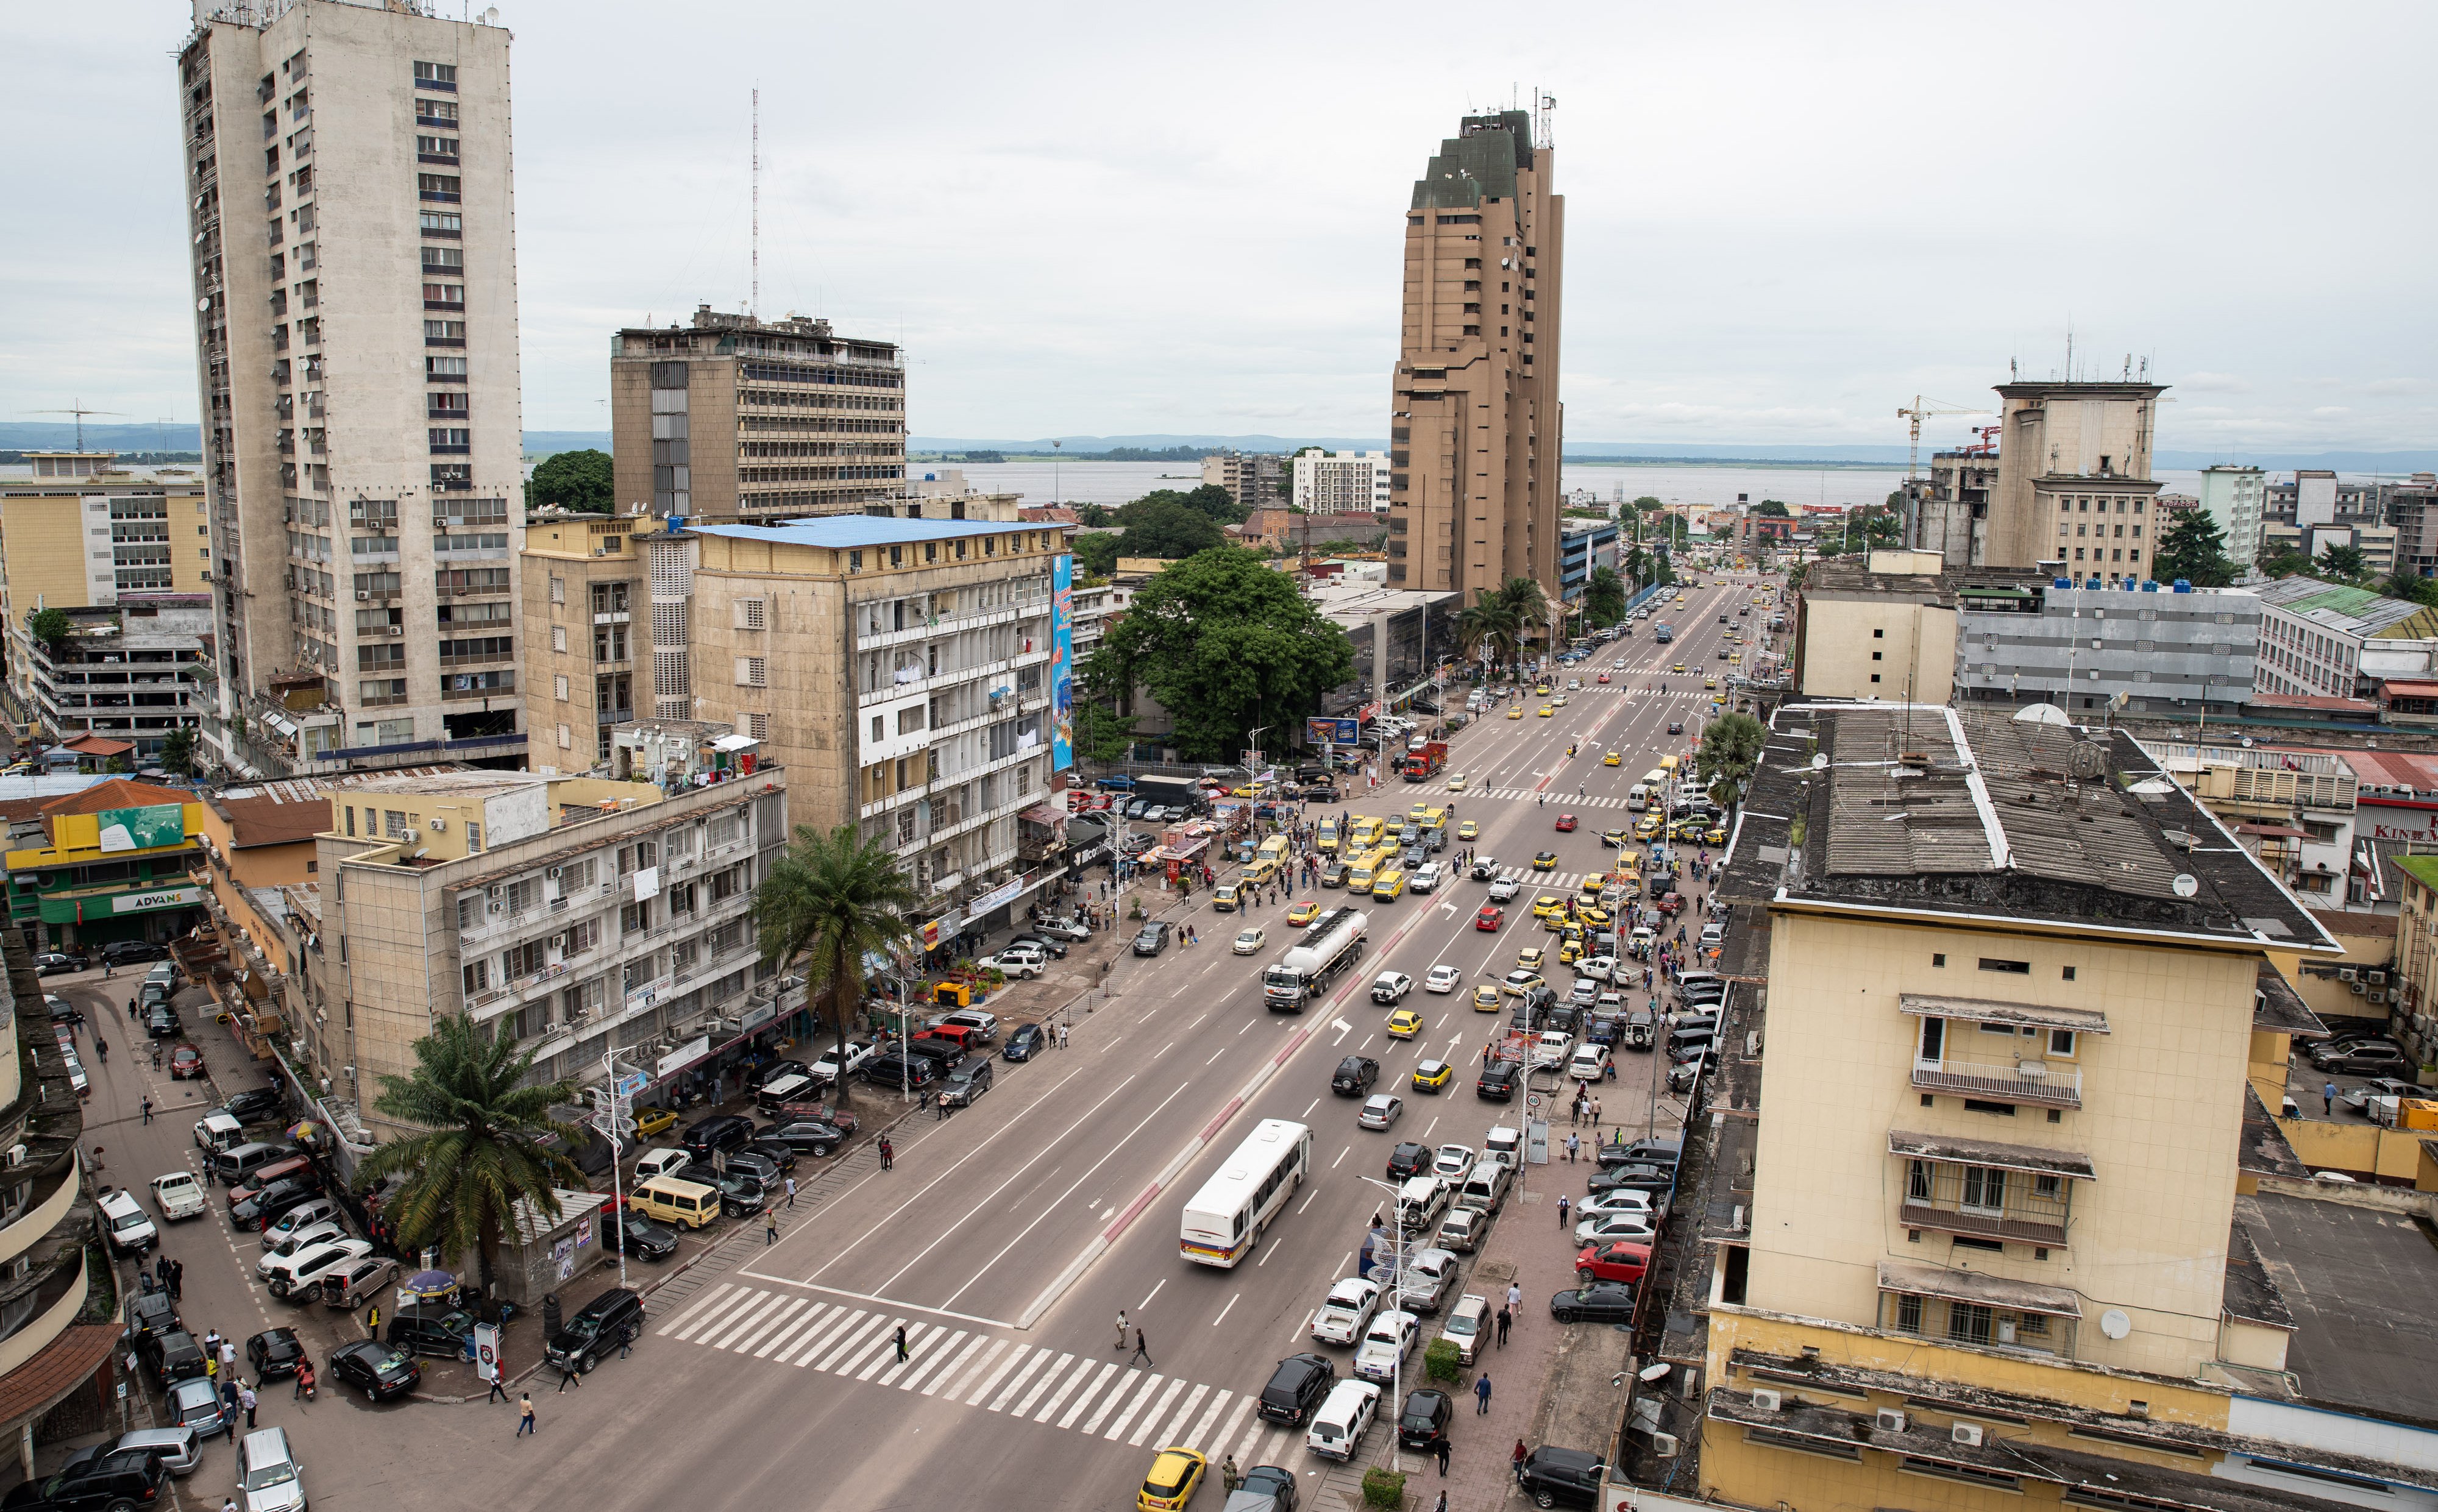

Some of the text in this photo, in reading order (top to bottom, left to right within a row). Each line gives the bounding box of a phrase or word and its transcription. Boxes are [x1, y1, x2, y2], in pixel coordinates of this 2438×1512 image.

[2374, 825, 2410, 840] KIN
[135, 893, 182, 907] ADVANS
[753, 1009, 767, 1020] LOBEX
